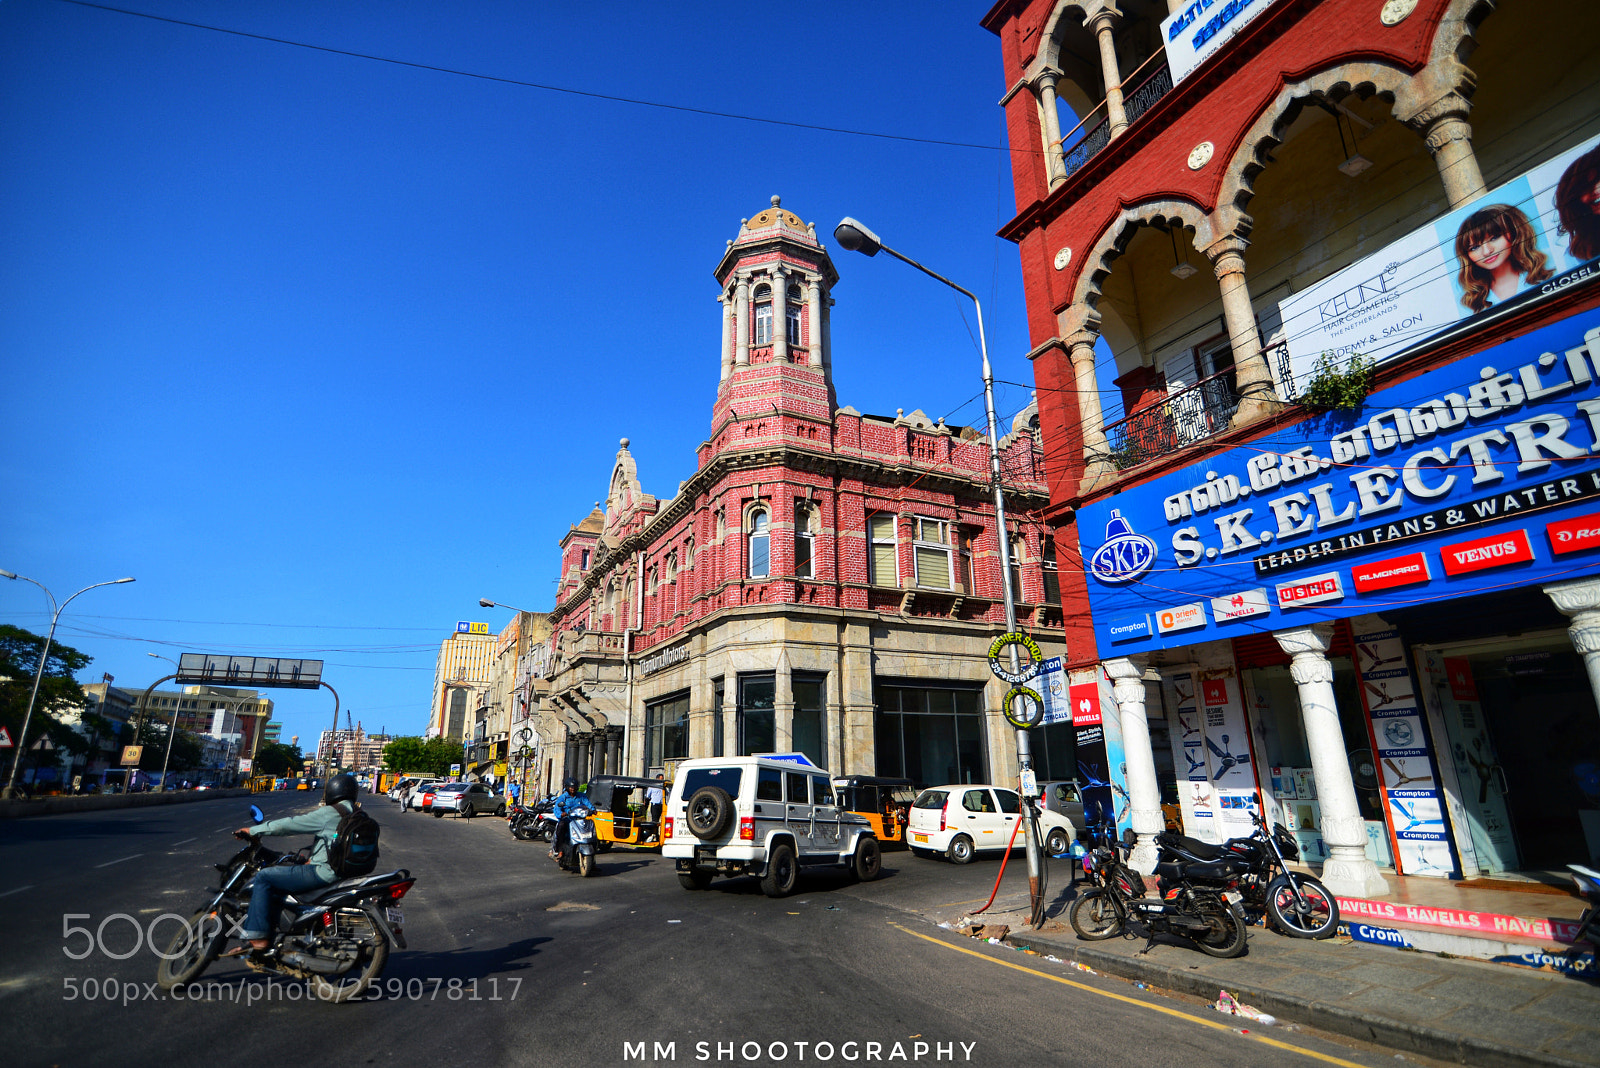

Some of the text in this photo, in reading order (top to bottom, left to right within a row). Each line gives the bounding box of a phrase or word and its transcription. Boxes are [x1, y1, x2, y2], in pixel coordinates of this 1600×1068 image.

[1382, 313, 1424, 338] SALON
[1258, 541, 1335, 571] LEADER
[1339, 533, 1365, 551] IN
[1372, 514, 1436, 545] FANS
[1446, 508, 1466, 525] &
[1473, 479, 1582, 519] WATER
[1100, 539, 1148, 577] SKE
[1453, 540, 1517, 565] VENUS
[1359, 564, 1420, 582] ALMONARD
[1282, 581, 1333, 600] USHA
[1175, 608, 1198, 619] orient
[1225, 608, 1255, 618] HAVELLS
[472, 623, 487, 633] LIC
[1110, 622, 1146, 634] Crompton
[1023, 636, 1042, 662] SHOP
[1074, 714, 1100, 722] HAVELLS
[1377, 709, 1412, 717] Crompton
[1394, 790, 1430, 798] Crompton
[1402, 832, 1440, 840] Crompton
[1407, 908, 1481, 928] HAVELLS
[1494, 917, 1580, 940] HAVELLS
